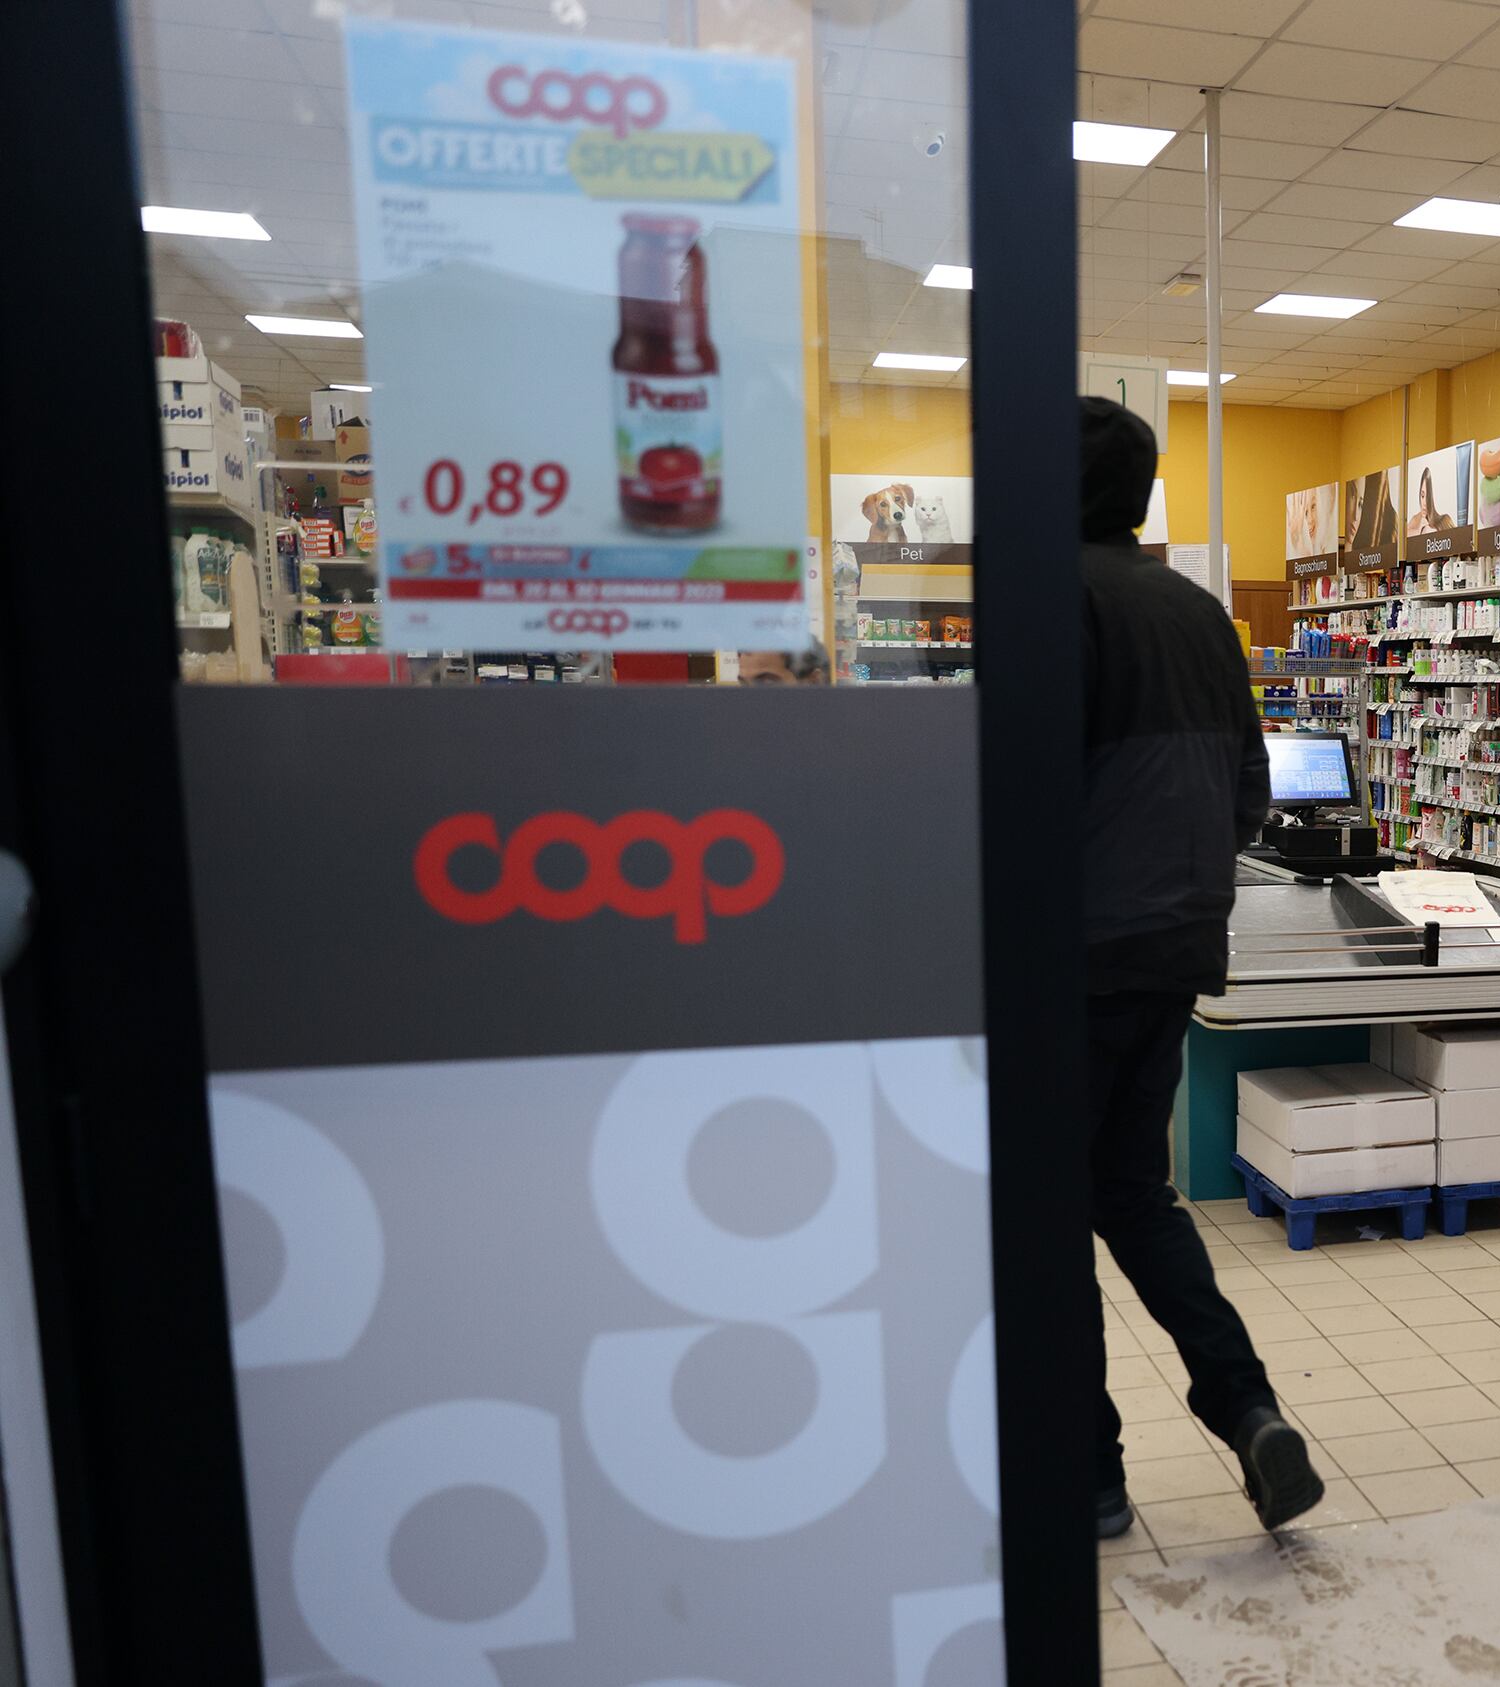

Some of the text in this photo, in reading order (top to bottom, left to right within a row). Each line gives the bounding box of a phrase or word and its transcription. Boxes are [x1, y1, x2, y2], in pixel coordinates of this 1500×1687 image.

[487, 64, 668, 139] coop
[377, 126, 758, 183] OFFERTE SPECIALI
[160, 403, 204, 420] ipiol
[423, 458, 570, 525] 0,89
[900, 547, 924, 561] Pet
[1426, 537, 1452, 554] Balsamo
[1294, 560, 1328, 576] Bagnoschiuma
[1358, 552, 1382, 567] Shampoo
[548, 608, 628, 639] coop
[412, 808, 786, 944] coop
